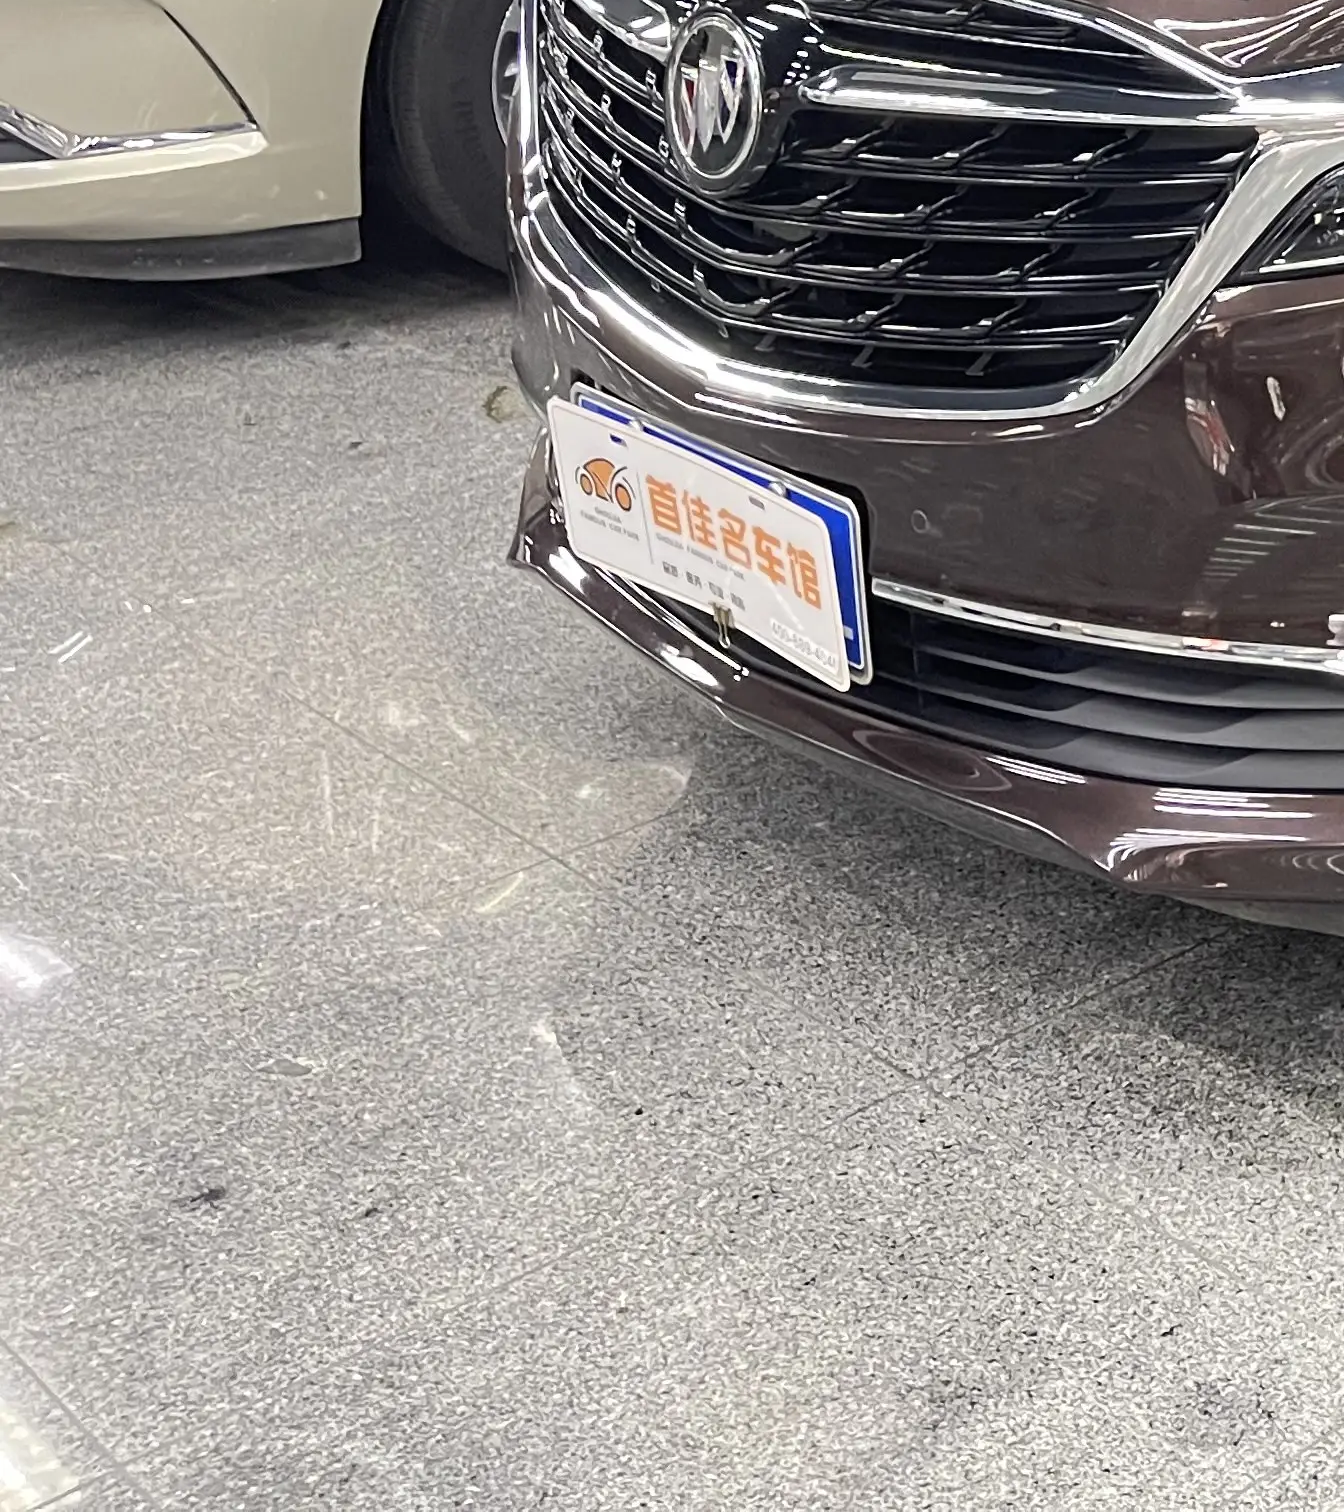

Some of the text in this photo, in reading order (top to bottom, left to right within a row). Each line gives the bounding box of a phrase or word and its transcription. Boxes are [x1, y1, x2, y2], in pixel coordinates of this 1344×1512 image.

[645, 472, 822, 611] 首佳名车馆
